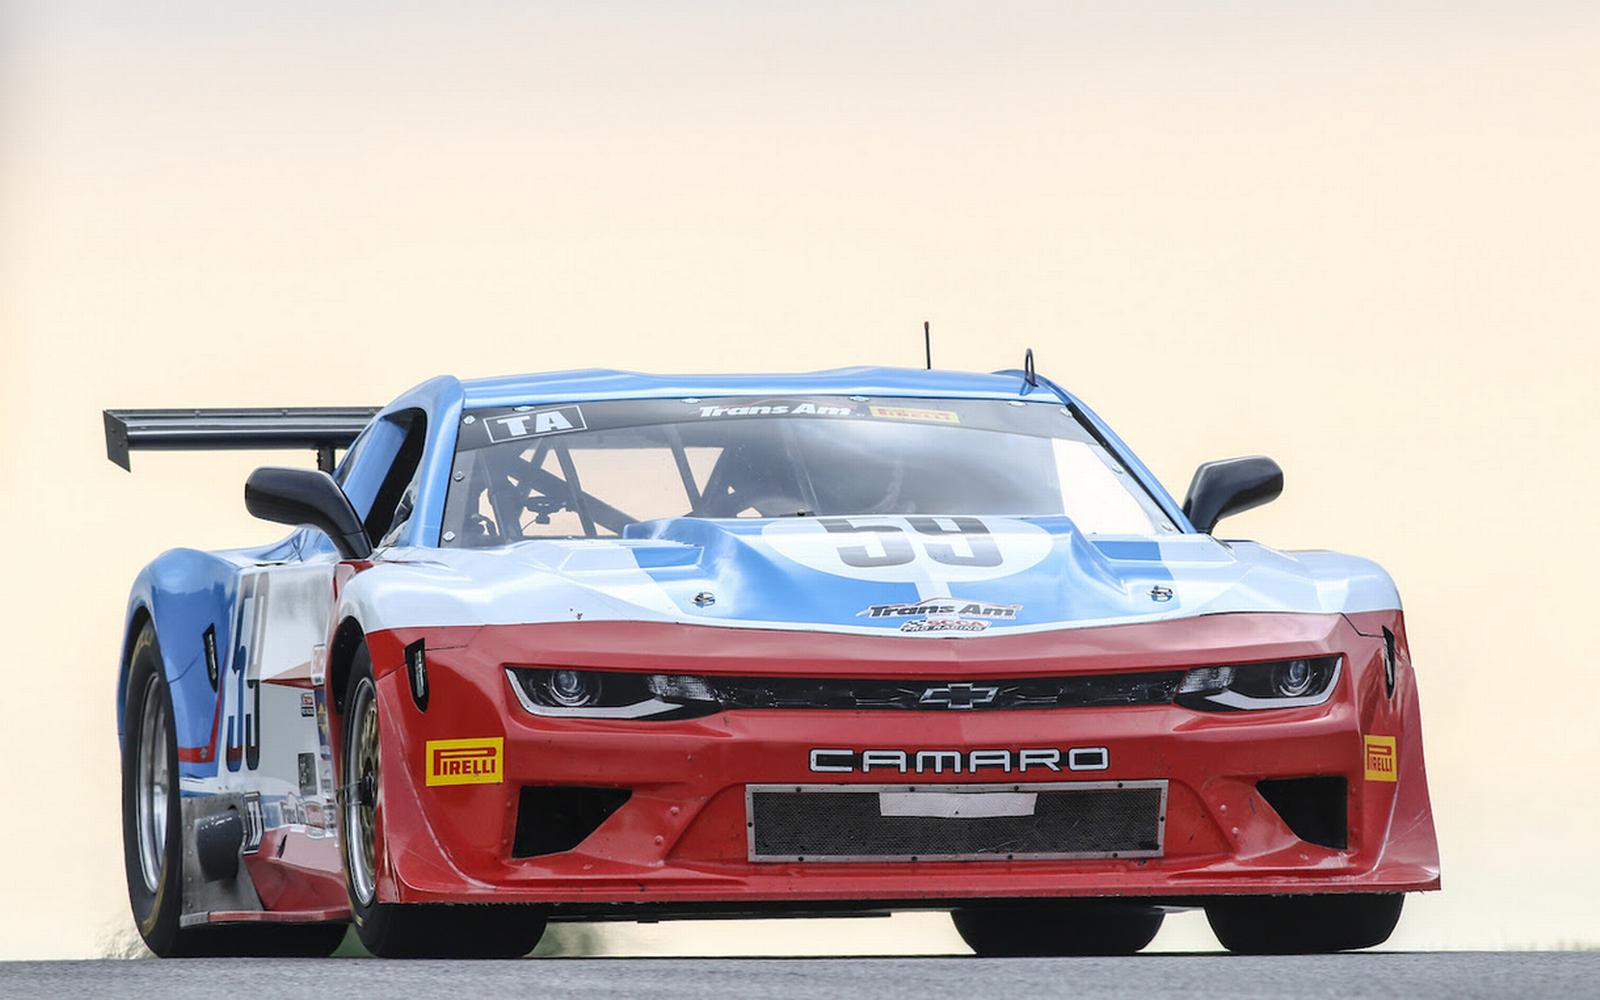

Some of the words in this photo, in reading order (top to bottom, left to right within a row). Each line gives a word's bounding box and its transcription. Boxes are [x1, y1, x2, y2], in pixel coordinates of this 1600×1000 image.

[496, 411, 573, 437] TA
[699, 405, 789, 417] Trans
[791, 403, 852, 416] Am
[816, 516, 1004, 568] 59
[870, 604, 955, 617] Trans
[957, 603, 1016, 617] Am
[432, 746, 497, 776] PIRELLI
[809, 746, 1109, 774] CAMARO
[1366, 743, 1392, 773] PIRELLI
